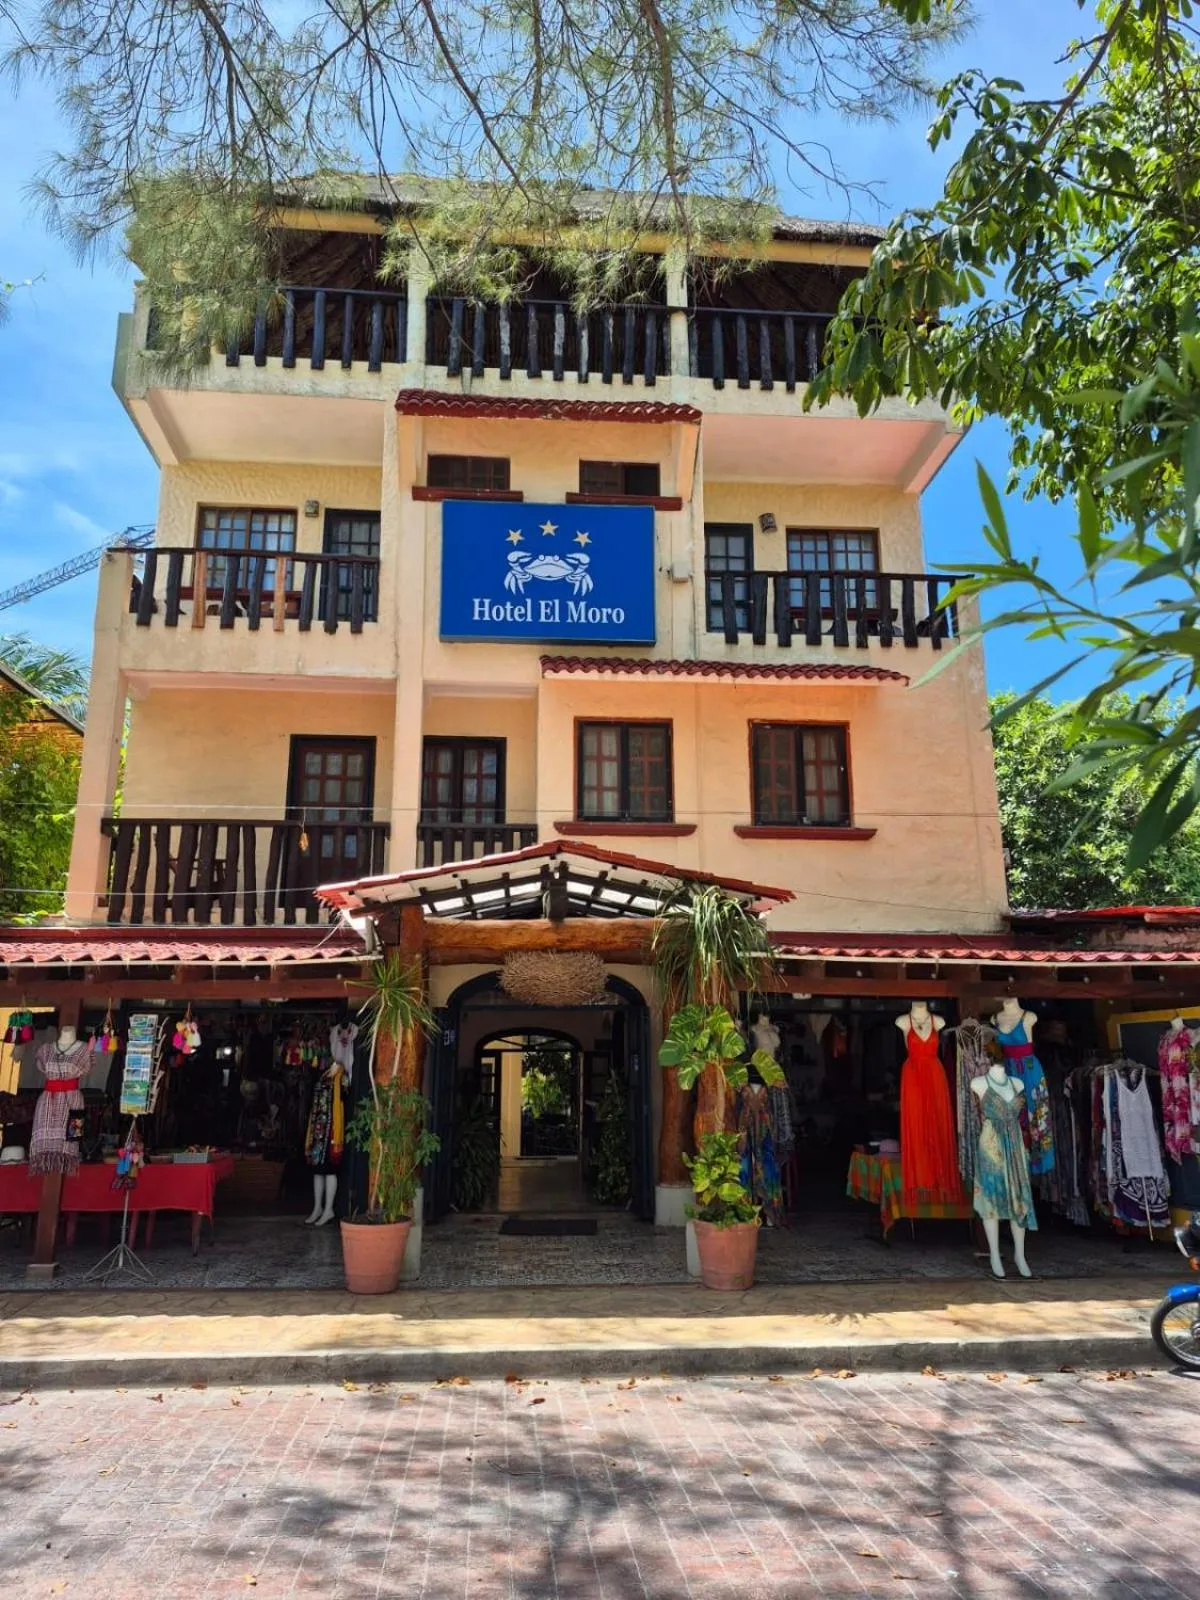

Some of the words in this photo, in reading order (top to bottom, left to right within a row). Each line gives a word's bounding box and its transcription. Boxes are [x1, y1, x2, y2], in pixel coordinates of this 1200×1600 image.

[472, 598, 533, 622] Hotel
[538, 599, 560, 623] El
[566, 601, 625, 624] Moro
